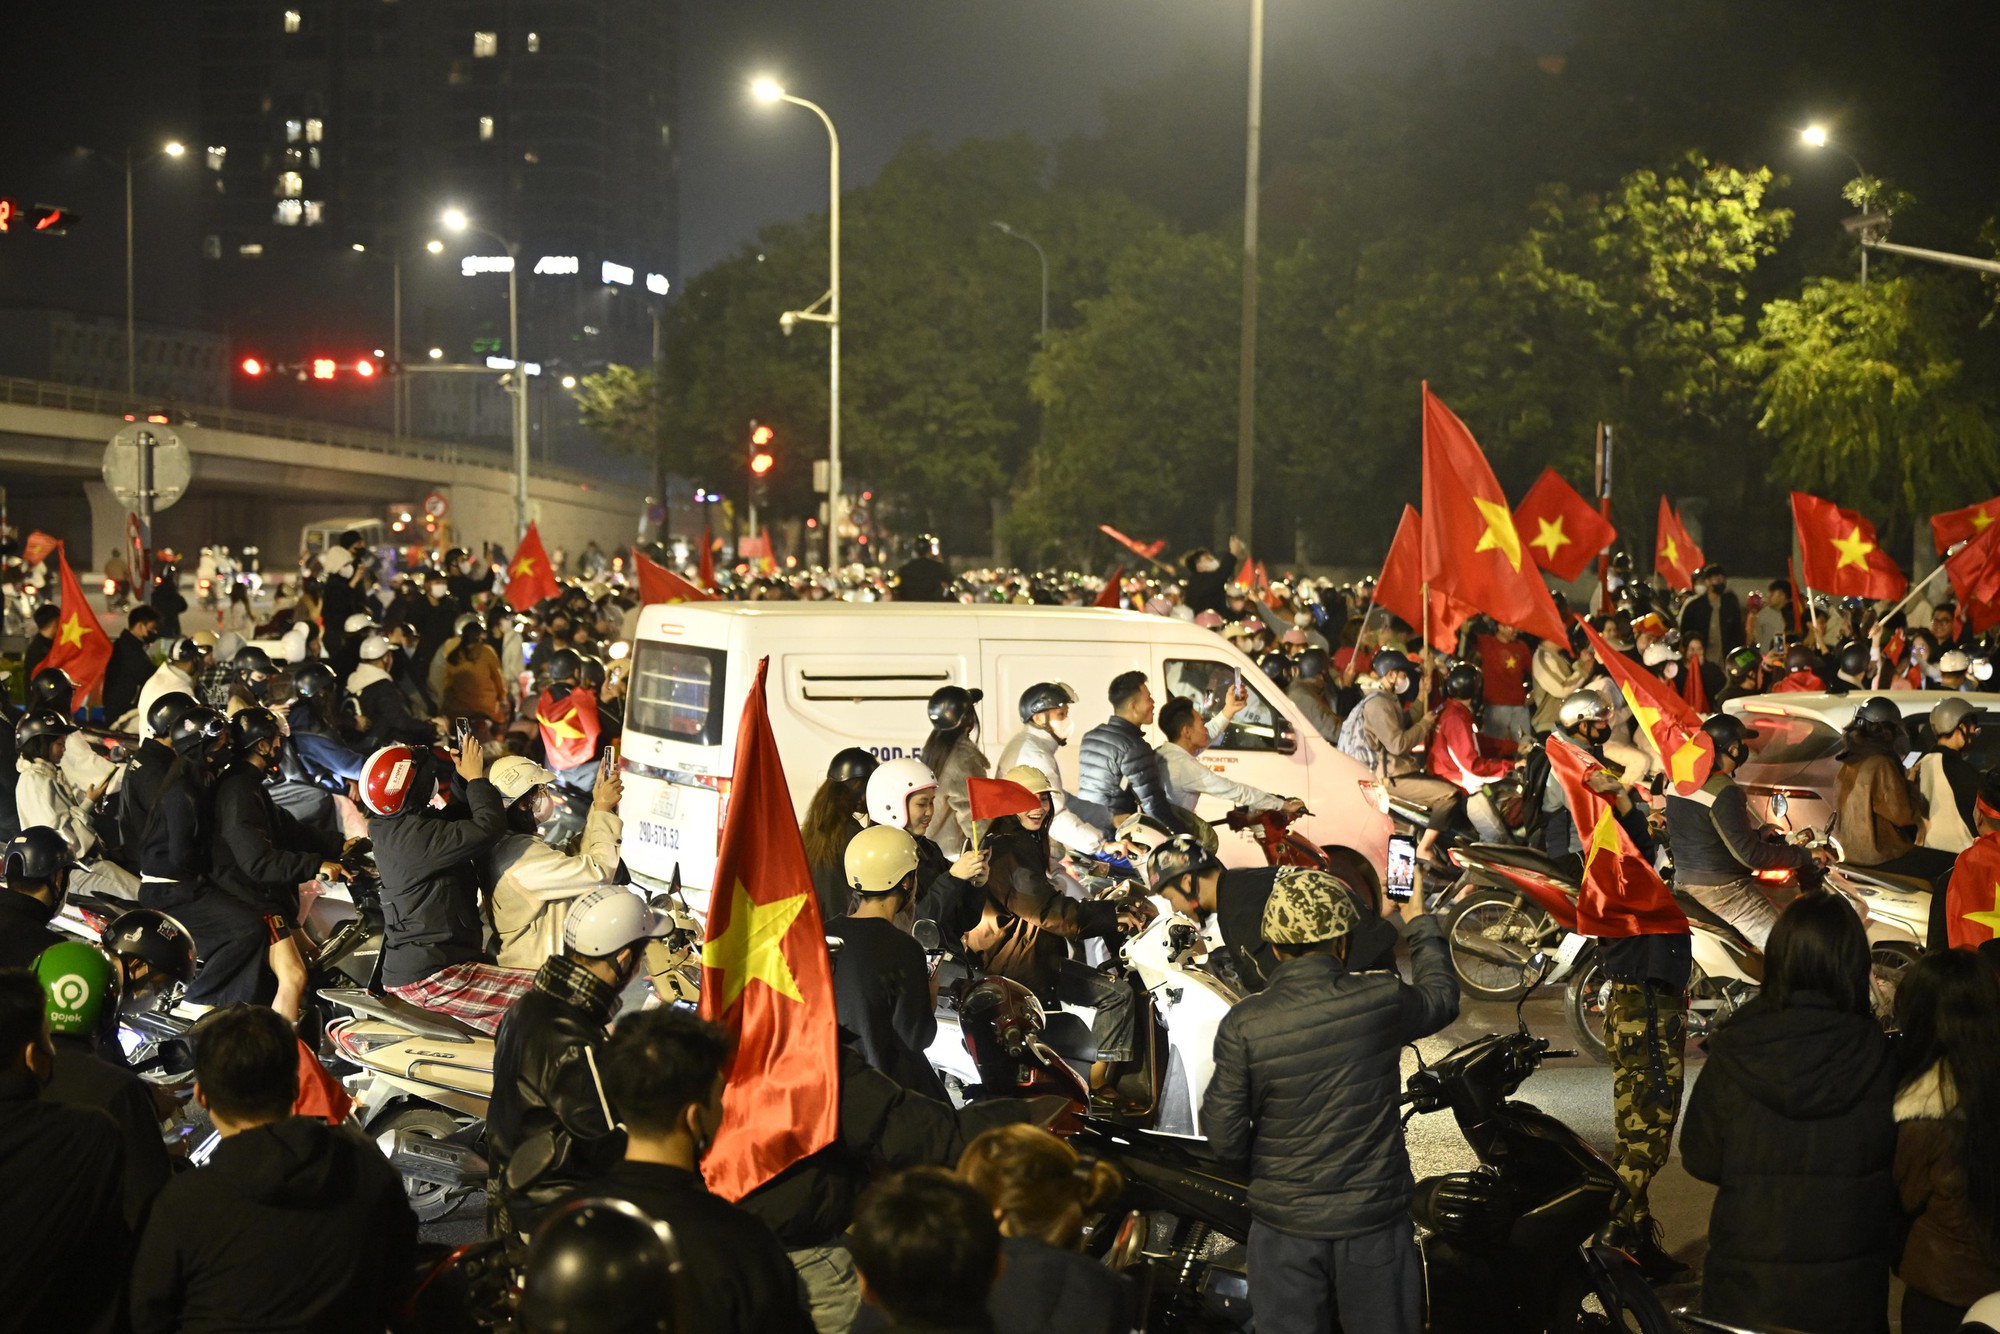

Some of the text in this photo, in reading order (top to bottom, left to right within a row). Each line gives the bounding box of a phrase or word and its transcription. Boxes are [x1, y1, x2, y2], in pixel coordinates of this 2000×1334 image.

[639, 820, 680, 851] 29D-576.52
[353, 949, 380, 957] HONDA
[50, 1011, 82, 1023] gojek
[404, 1048, 456, 1059] LEAD
